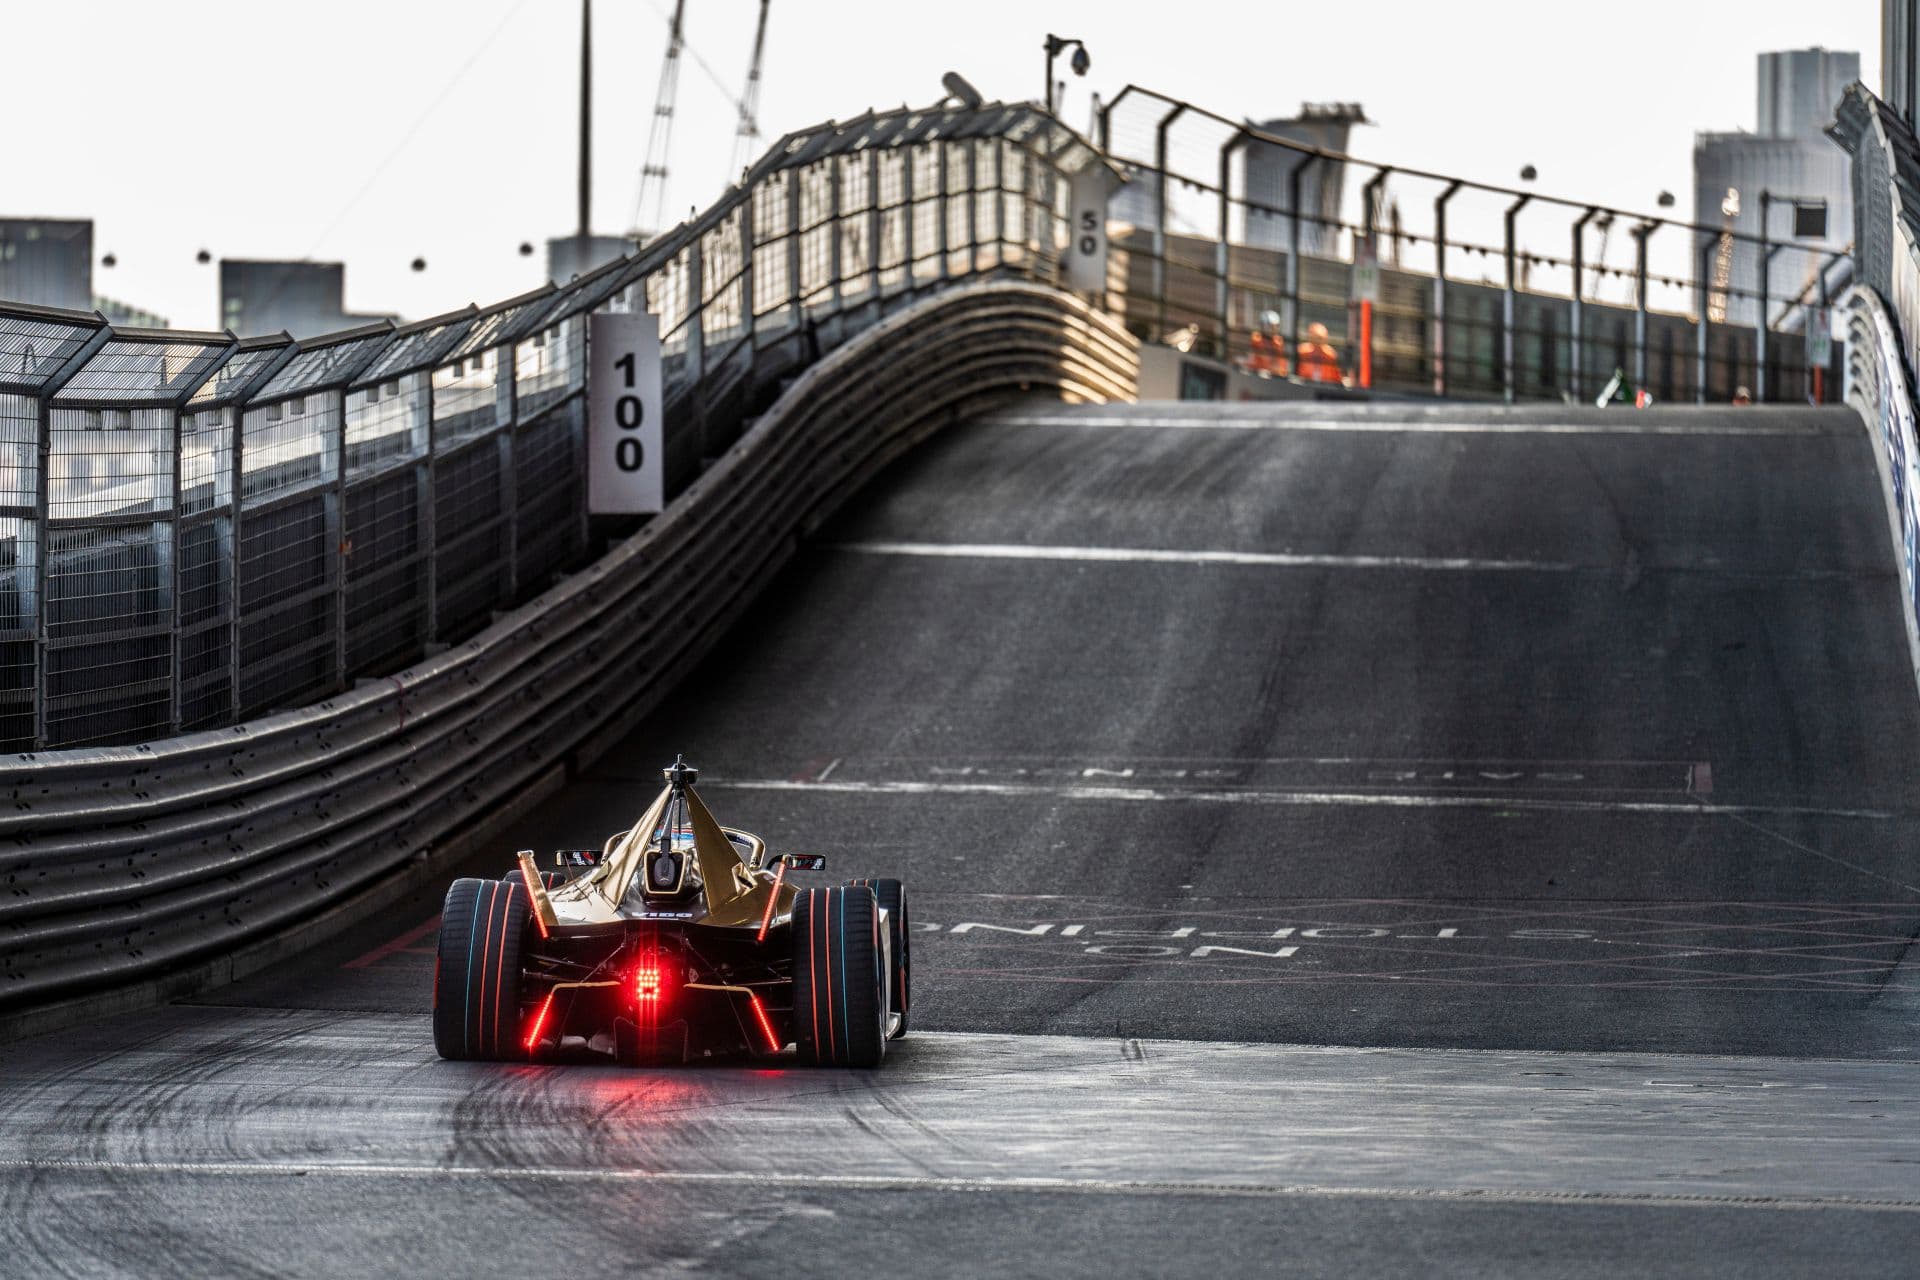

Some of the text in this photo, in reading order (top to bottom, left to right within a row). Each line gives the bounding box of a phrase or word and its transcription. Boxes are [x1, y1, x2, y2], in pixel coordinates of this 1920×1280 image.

[1079, 210, 1098, 257] 50
[614, 352, 644, 473] 100
[1083, 945, 1301, 958] NO
